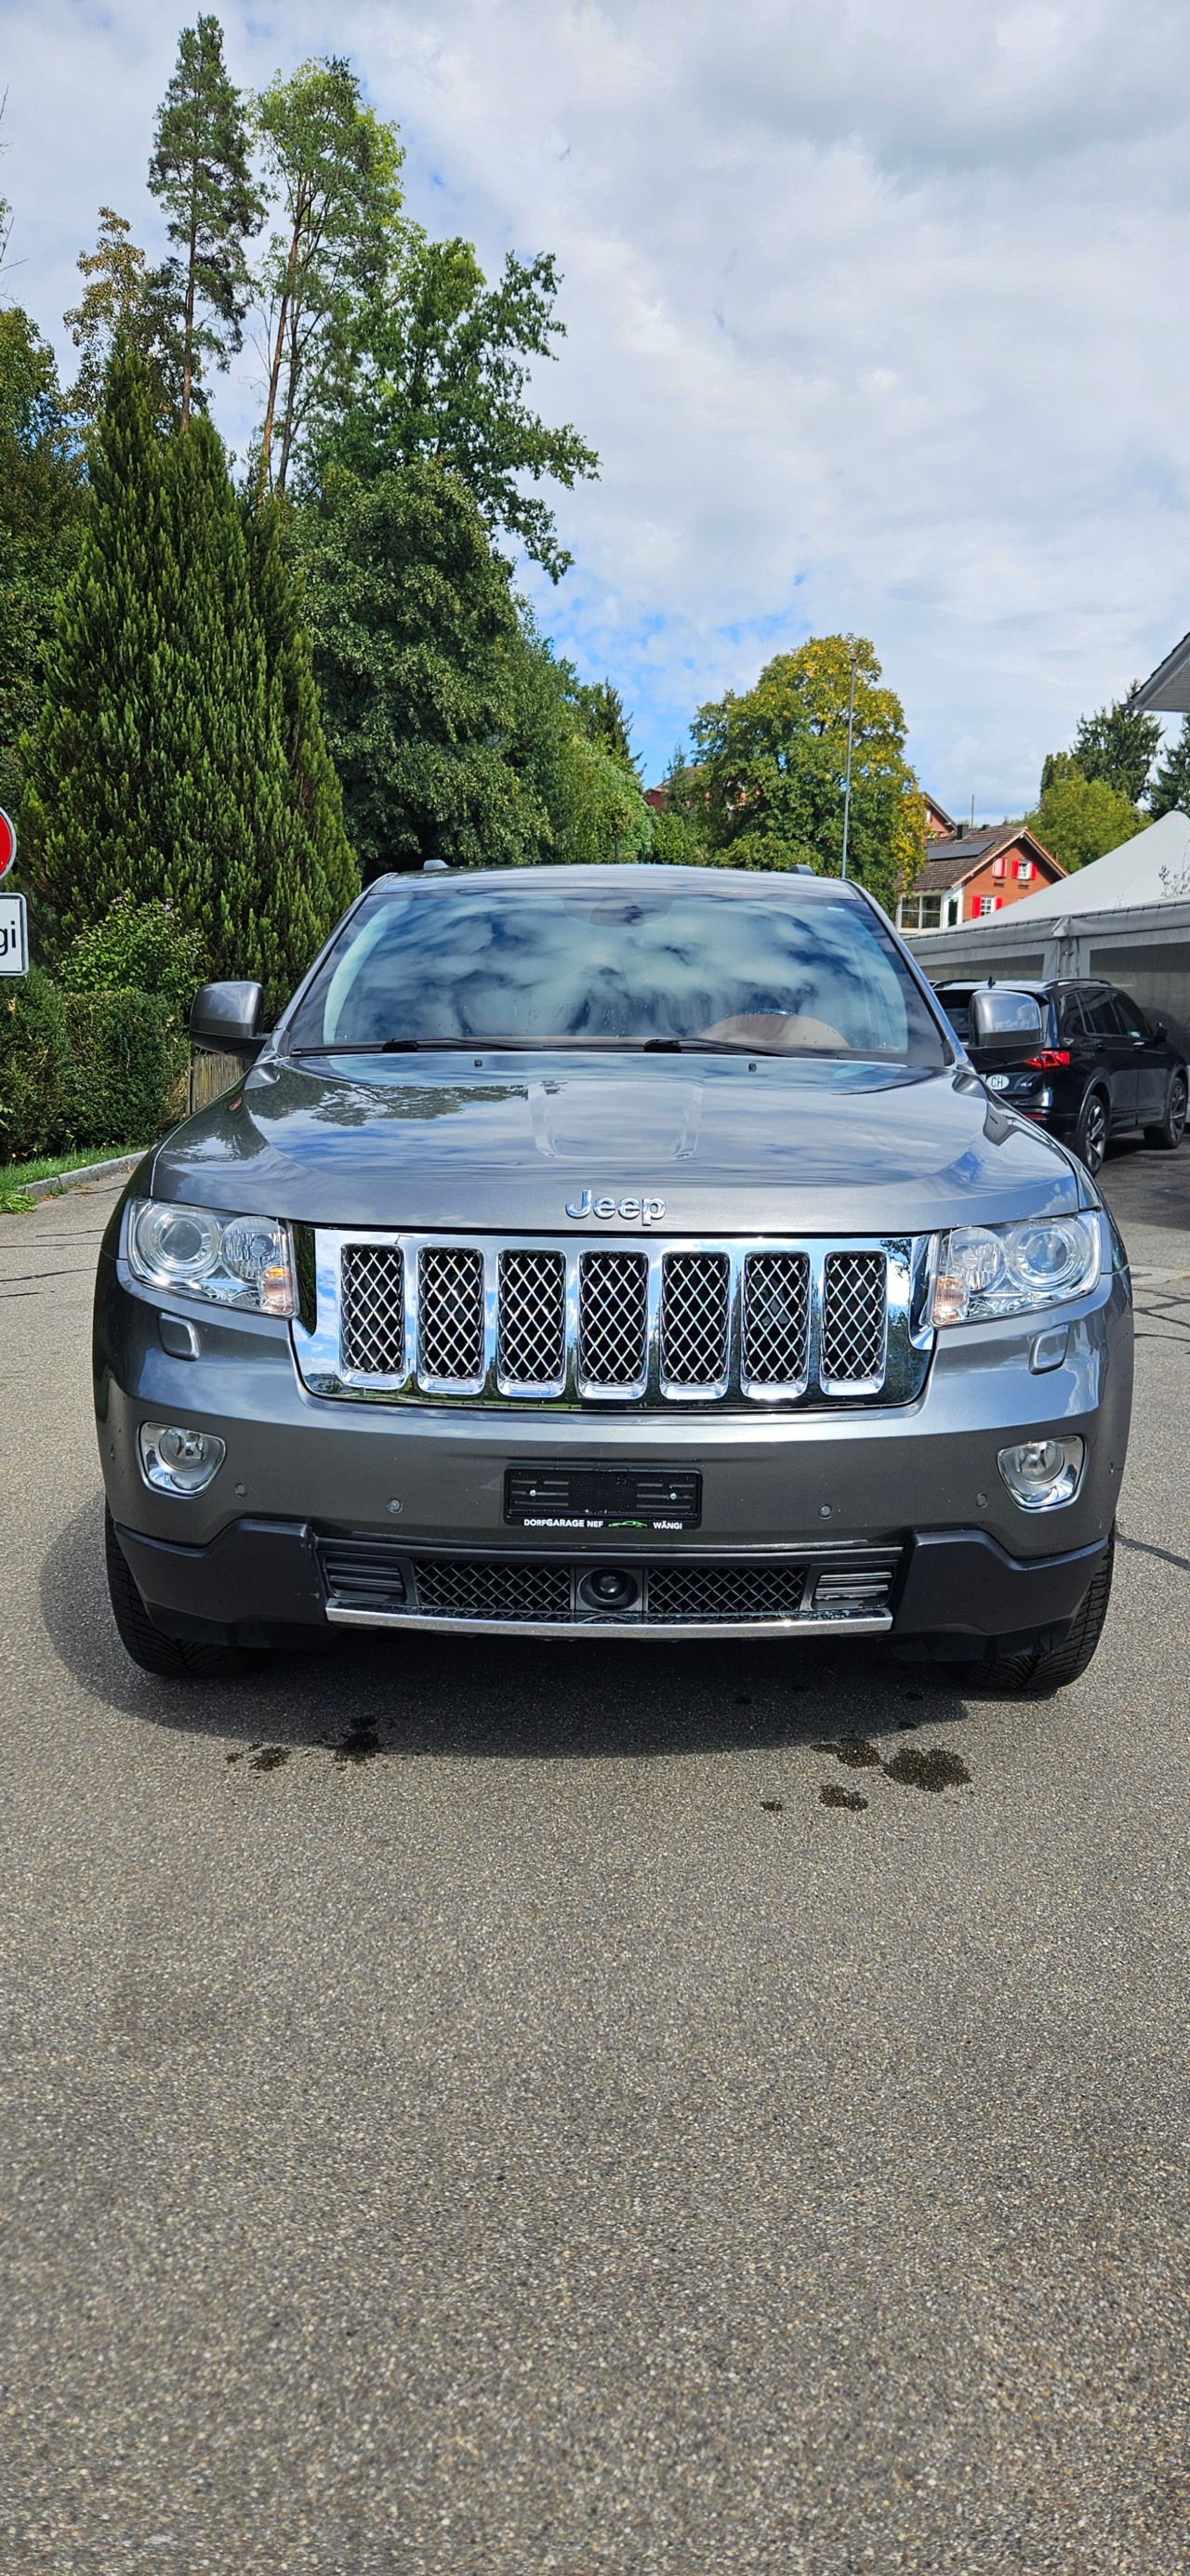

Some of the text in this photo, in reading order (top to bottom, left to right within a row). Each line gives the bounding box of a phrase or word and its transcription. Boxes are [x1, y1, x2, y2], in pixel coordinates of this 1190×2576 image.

[990, 1077, 1004, 1089] CH
[565, 1189, 667, 1226] Jeep
[523, 1518, 585, 1527] DORFGARAGE
[653, 1520, 682, 1530] WÄNGI
